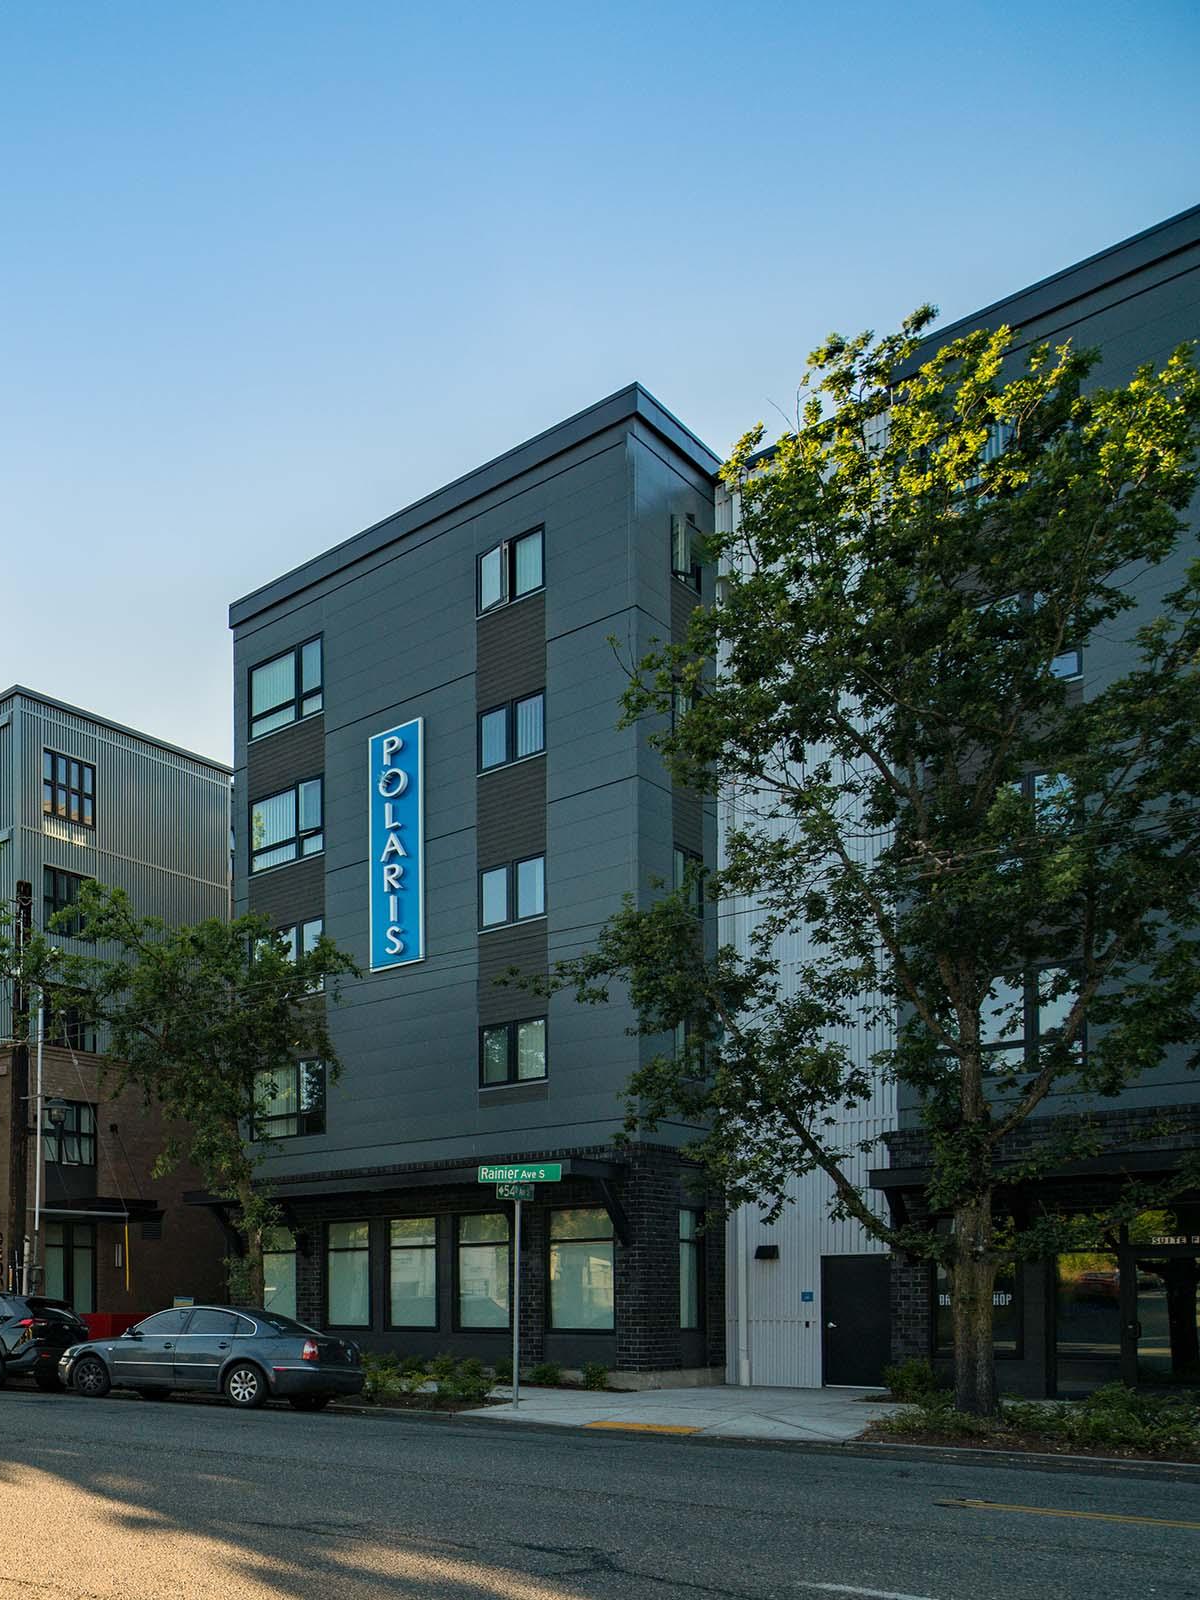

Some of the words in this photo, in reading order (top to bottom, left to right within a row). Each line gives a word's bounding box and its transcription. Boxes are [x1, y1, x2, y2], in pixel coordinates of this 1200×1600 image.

[378, 735, 408, 954] POLARIS
[481, 1167, 519, 1180] Rainier
[520, 1170, 536, 1179] Ave
[538, 1169, 545, 1179] S
[1152, 1236, 1187, 1245] SUITE
